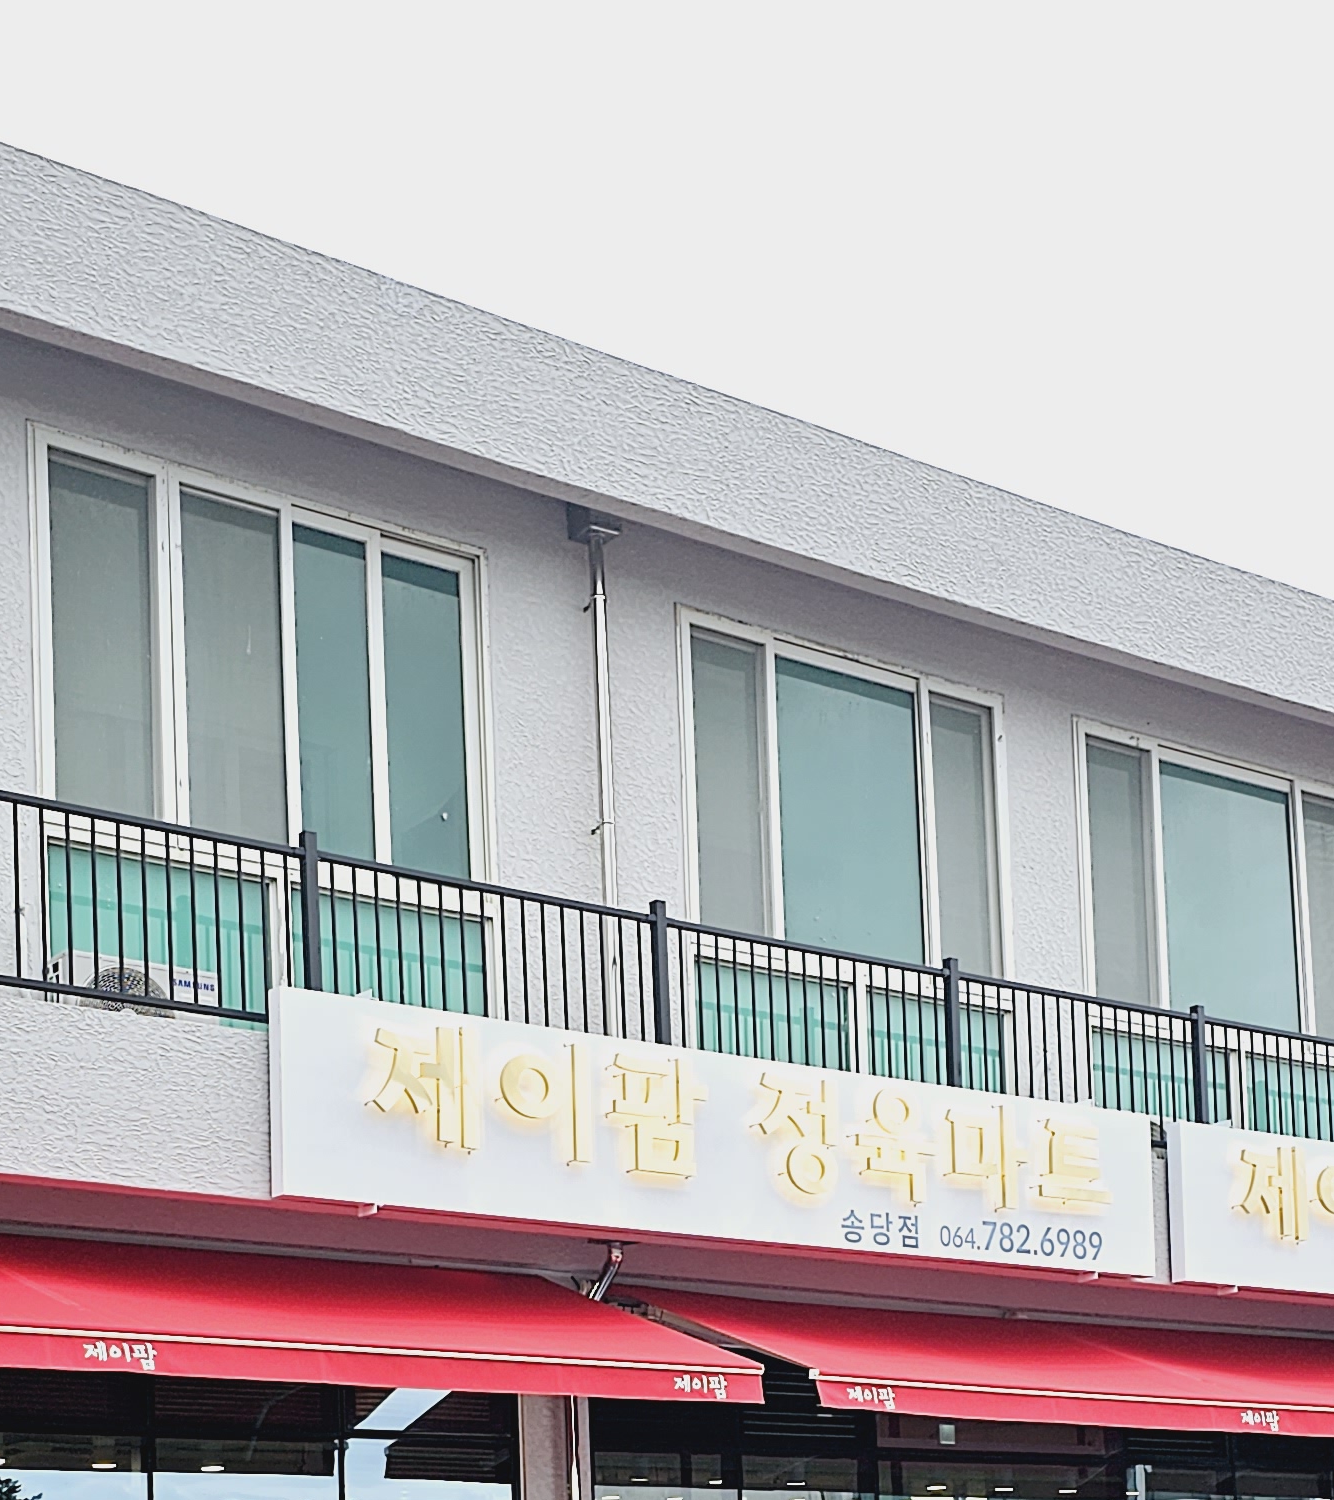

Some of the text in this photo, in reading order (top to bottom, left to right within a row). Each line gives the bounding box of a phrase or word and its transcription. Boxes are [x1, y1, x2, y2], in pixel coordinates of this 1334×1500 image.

[171, 979, 215, 991] SAMUNG
[364, 1026, 1113, 1213] 제이팜 정육마트
[841, 1209, 1104, 1261] 송당점 064.782.6989
[83, 1341, 158, 1371] 제이팜
[673, 1374, 727, 1400] 제이팜
[846, 1386, 896, 1410] 제이팜
[1240, 1410, 1280, 1432] 제이팜
